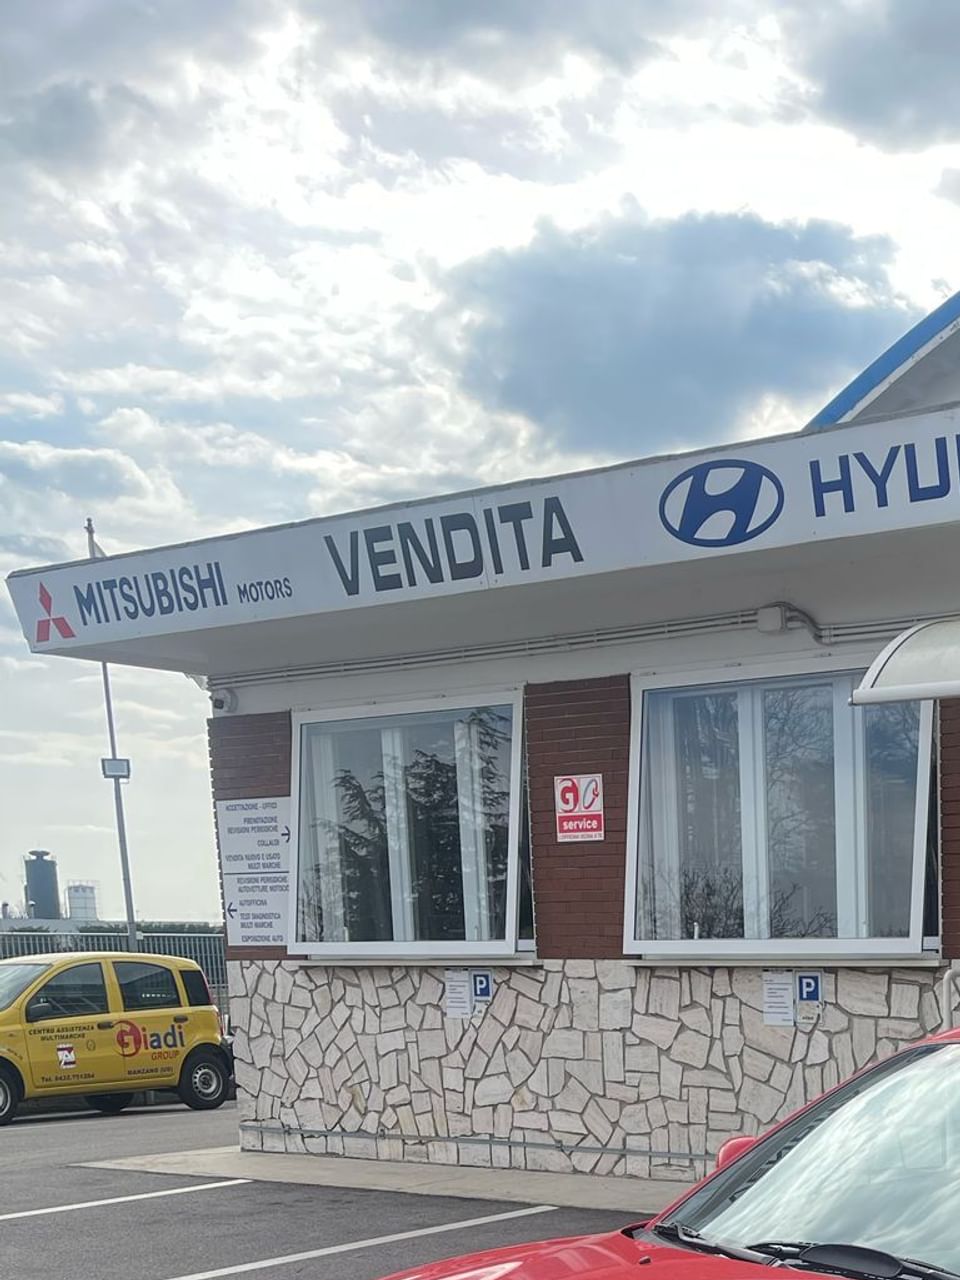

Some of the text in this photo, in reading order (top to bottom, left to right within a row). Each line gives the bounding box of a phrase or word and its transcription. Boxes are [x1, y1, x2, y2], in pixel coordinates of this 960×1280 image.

[323, 496, 584, 596] VENDITA
[73, 561, 293, 626] MITSUBISHI MOTORS
[563, 818, 598, 830] service
[151, 1050, 180, 1061] GROUP
